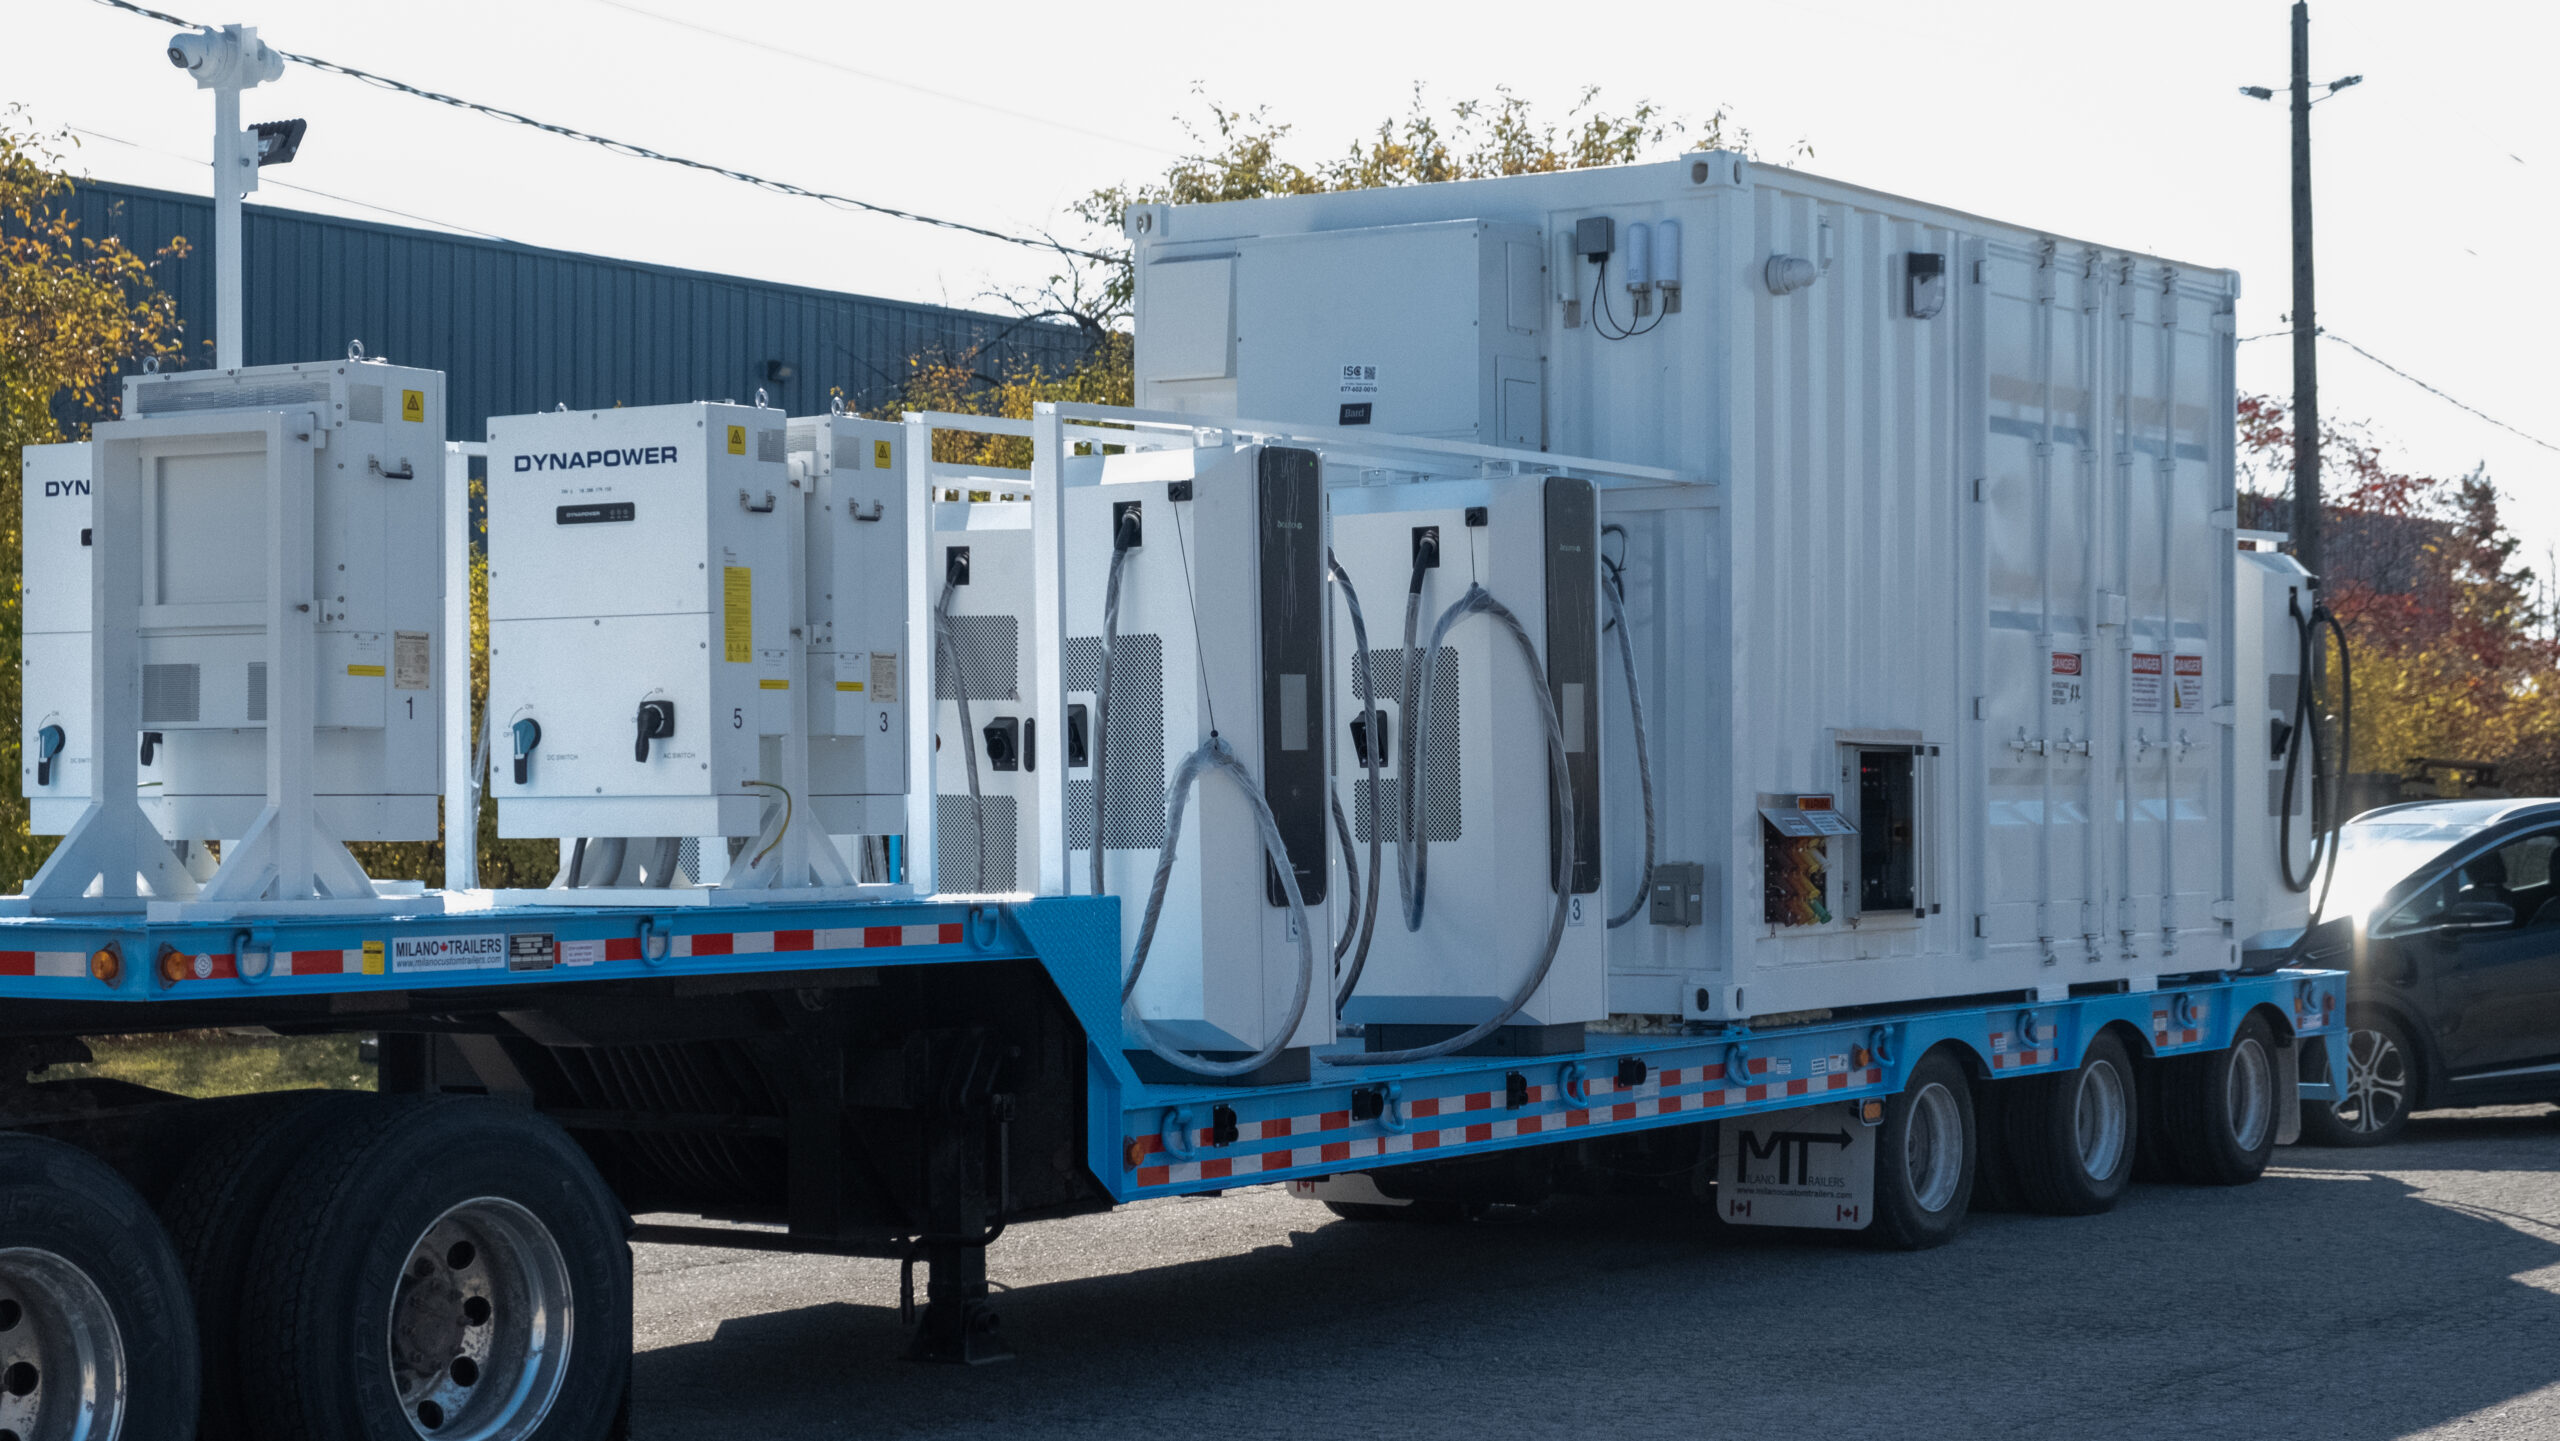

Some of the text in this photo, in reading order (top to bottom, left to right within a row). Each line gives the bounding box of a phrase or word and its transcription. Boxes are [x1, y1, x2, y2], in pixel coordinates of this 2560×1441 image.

[1343, 366, 1361, 376] ISC
[1344, 408, 1365, 418] Bard
[514, 445, 678, 472] DYNAPOWER
[45, 479, 90, 497] DYN
[2132, 656, 2160, 671] DANGER
[2175, 658, 2201, 672] DANGER
[406, 696, 413, 720] 1
[733, 707, 743, 729] 5
[880, 711, 889, 732] 3
[1572, 898, 1581, 921] 3
[396, 940, 439, 957] MILANO
[448, 938, 502, 955] TRAILERS
[396, 955, 502, 968] www.milanocustomtrailers.com
